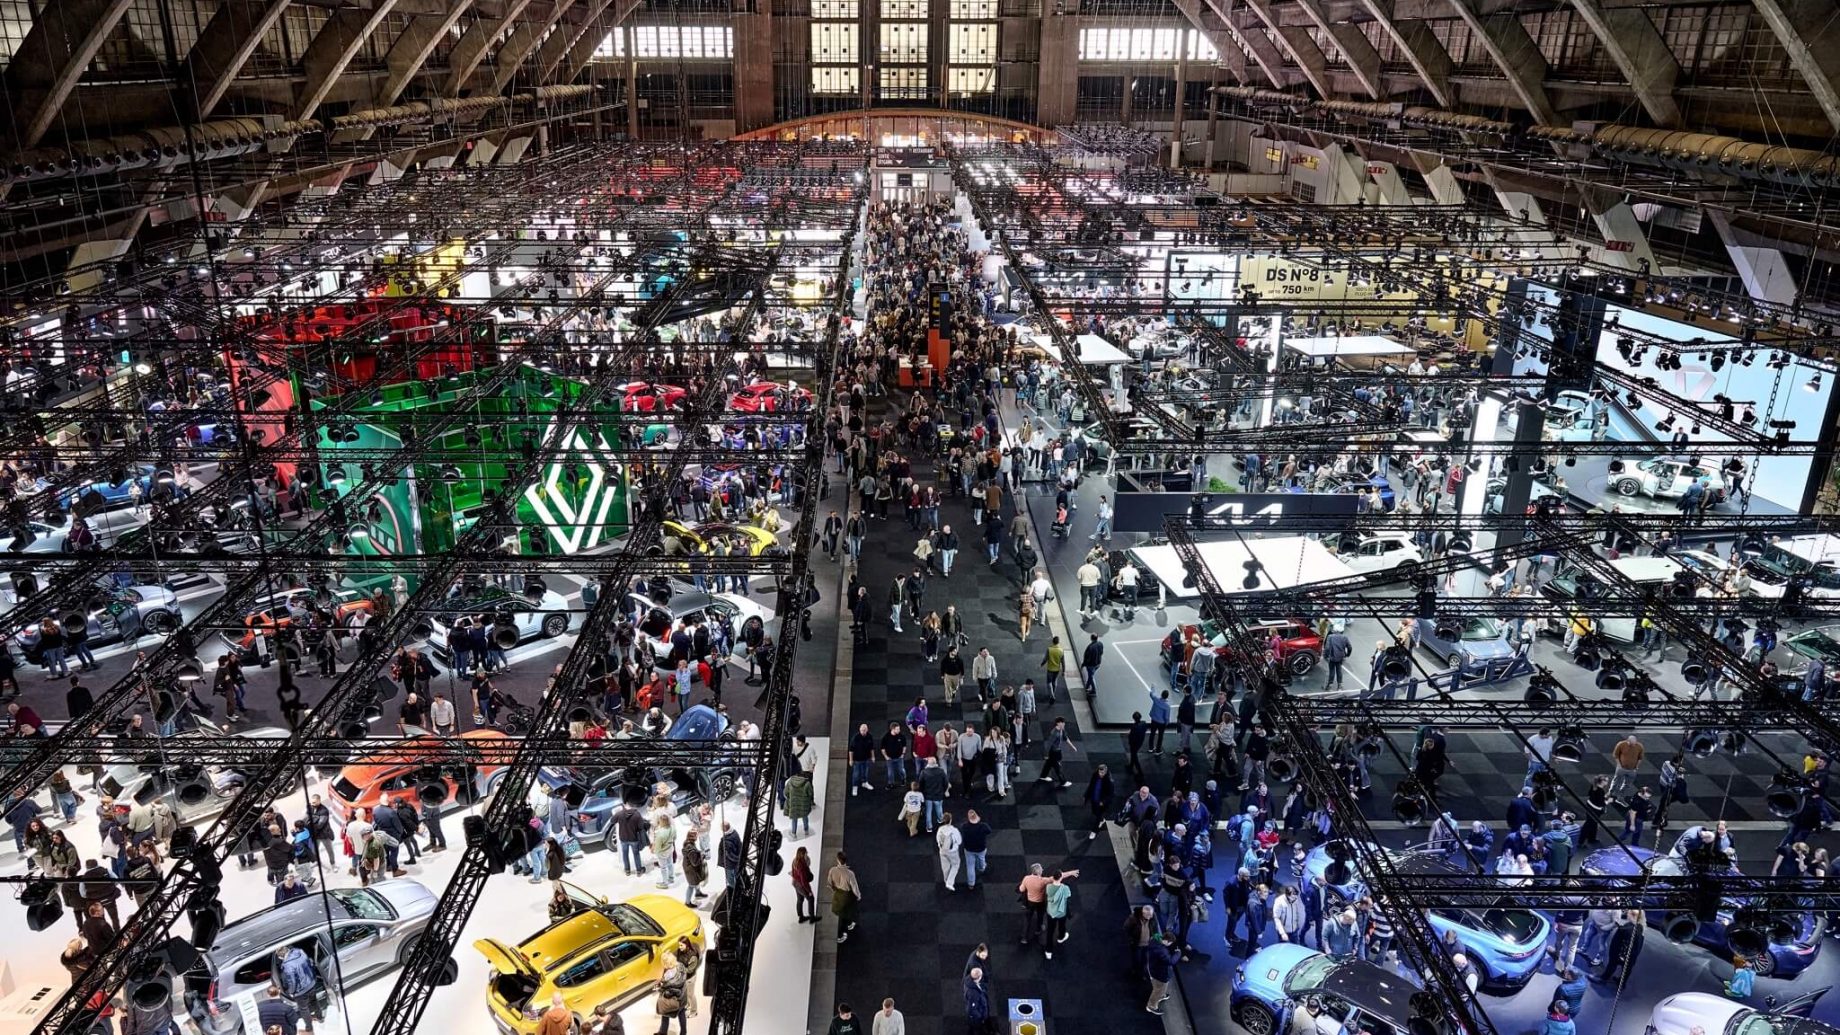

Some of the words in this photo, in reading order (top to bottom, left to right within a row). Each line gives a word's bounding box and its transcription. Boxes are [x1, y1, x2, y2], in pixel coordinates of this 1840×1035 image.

[1266, 268, 1287, 281] DS
[1290, 268, 1319, 281] N°8
[1282, 285, 1302, 294] 750
